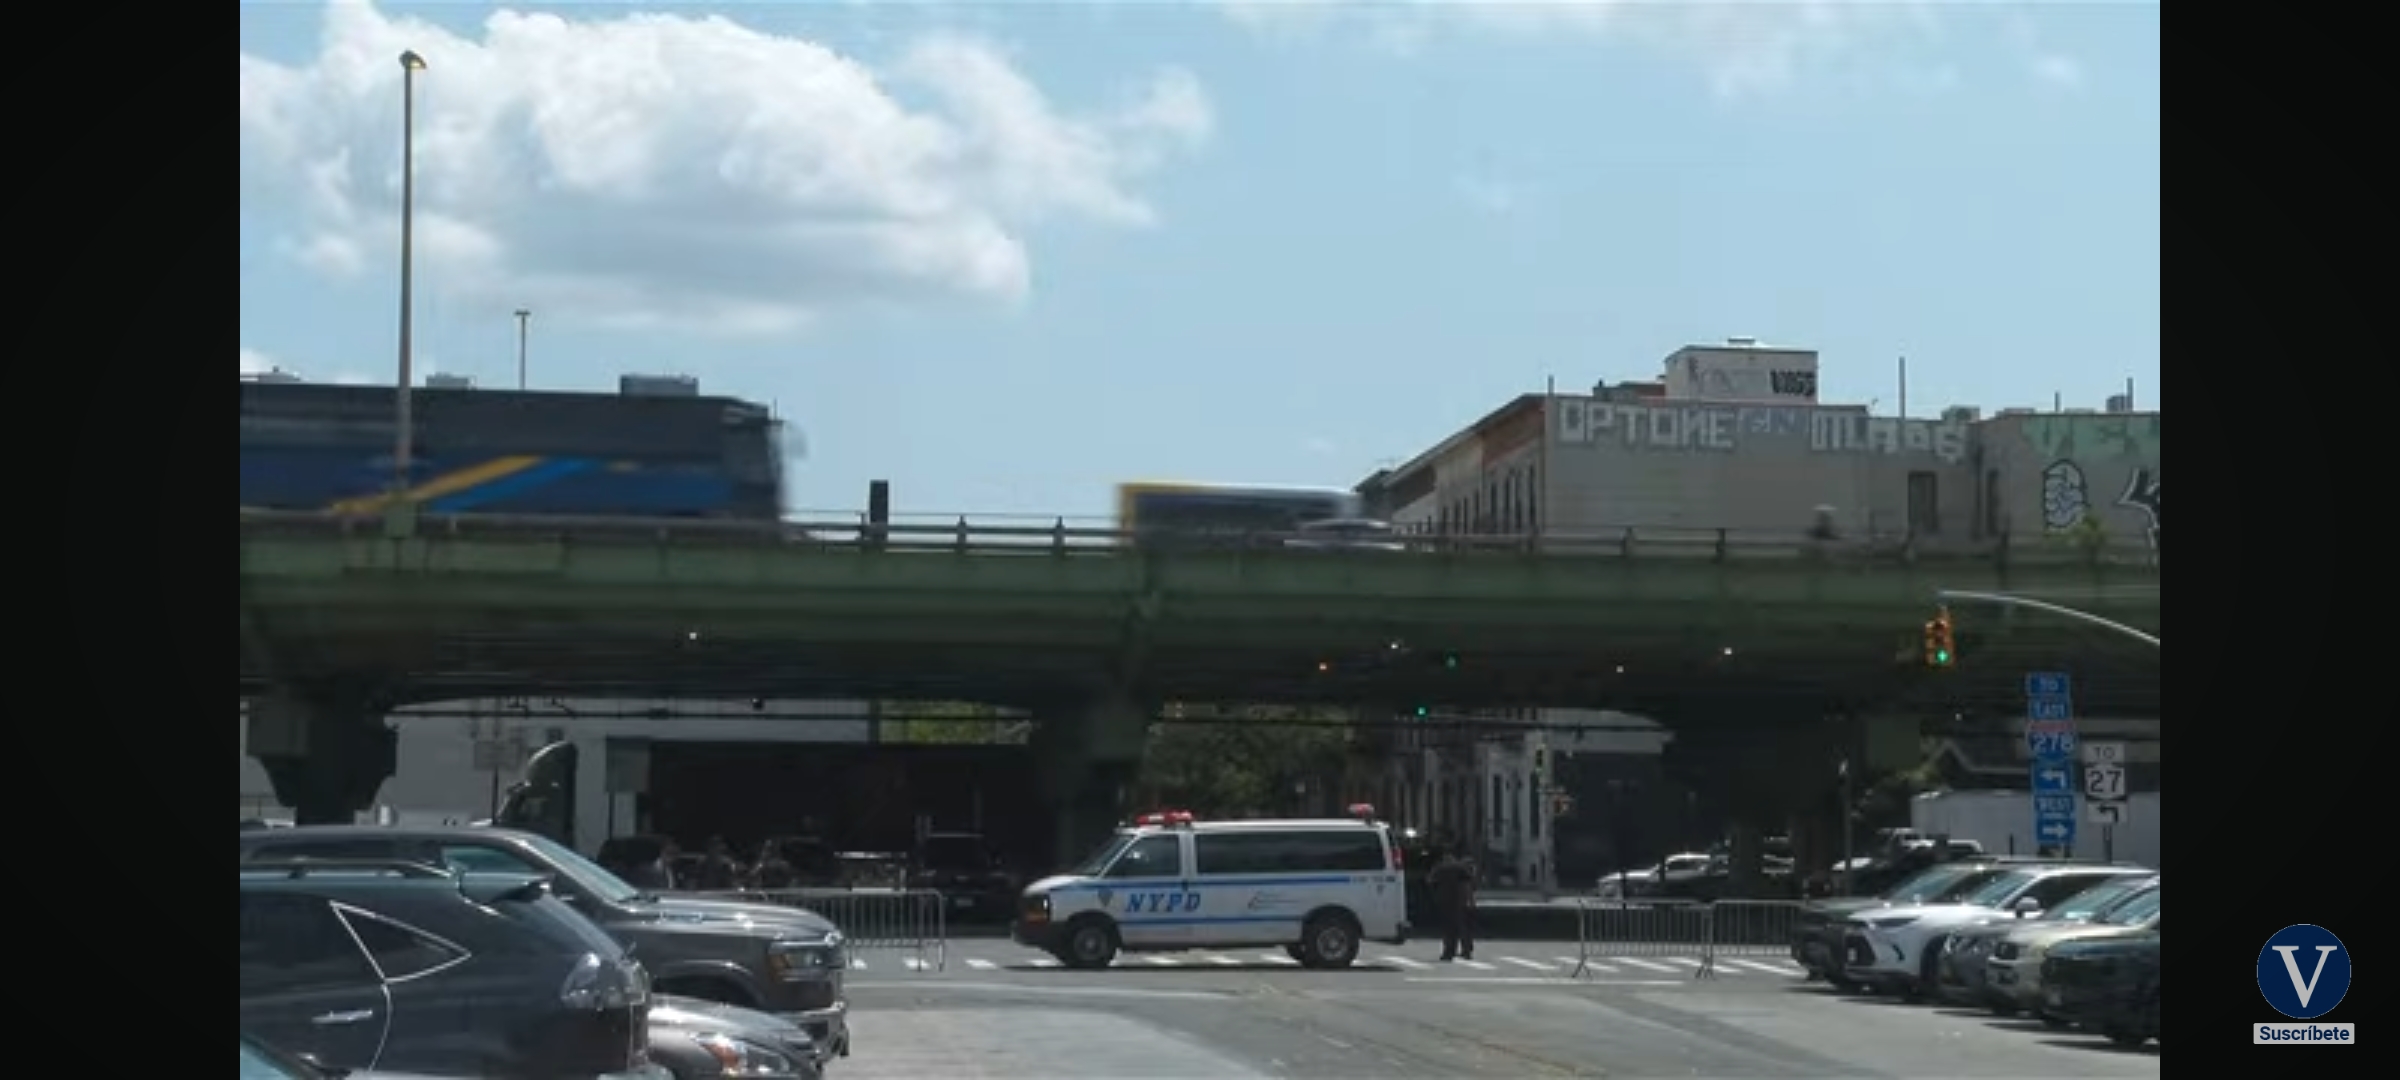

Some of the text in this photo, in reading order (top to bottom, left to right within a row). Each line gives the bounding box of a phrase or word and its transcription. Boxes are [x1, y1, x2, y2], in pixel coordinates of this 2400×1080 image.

[2031, 733, 2074, 753] 278
[2093, 747, 2115, 760] TO
[2088, 770, 2122, 793] 27
[2037, 797, 2071, 811] WEST
[1124, 892, 1202, 914] NYPD
